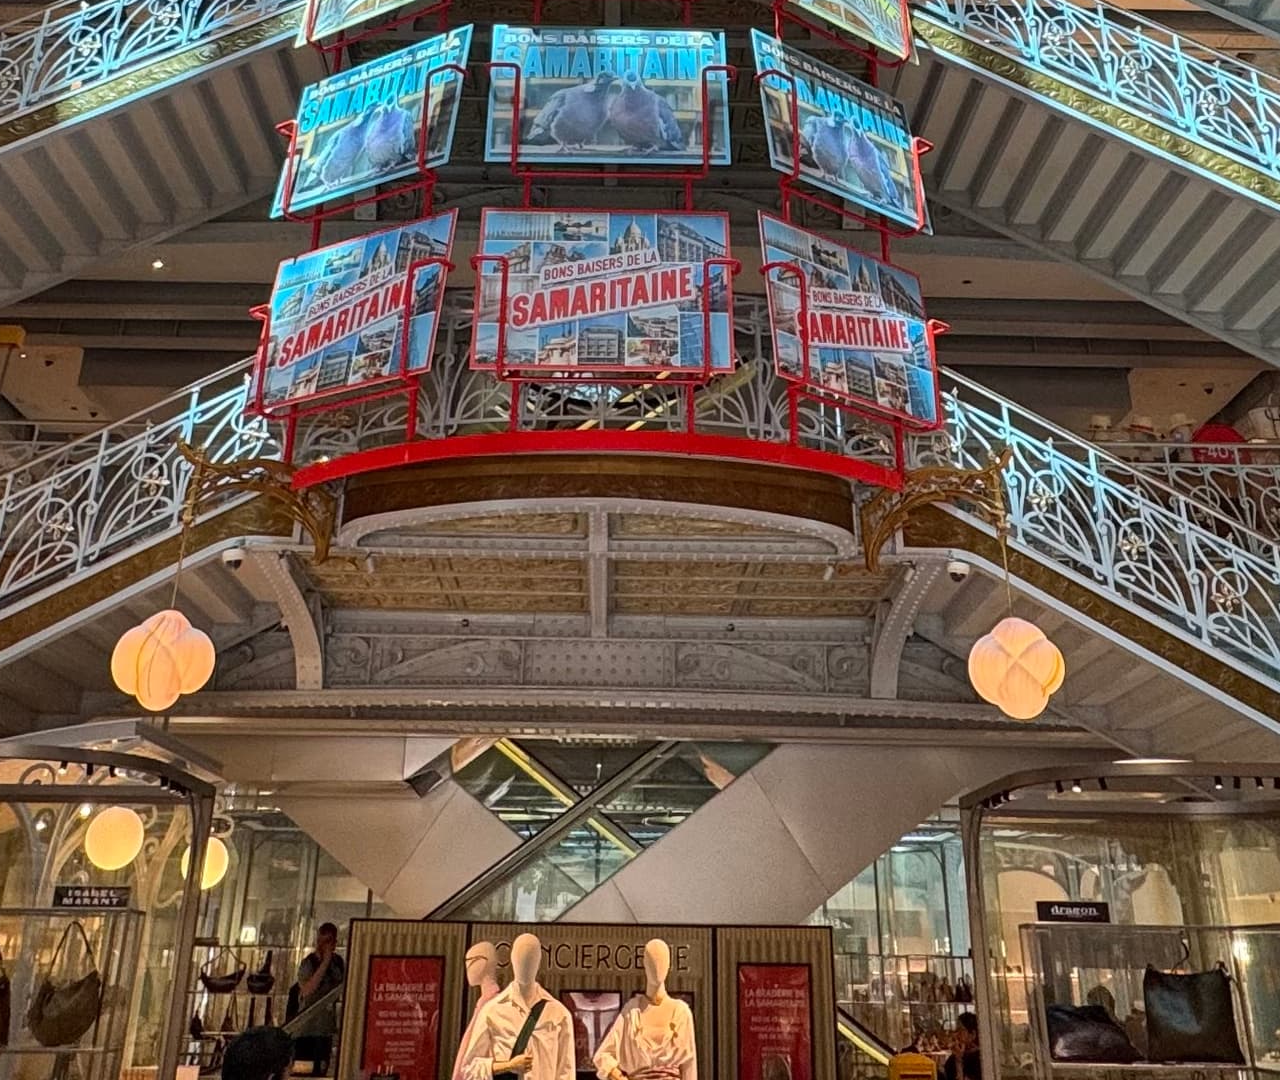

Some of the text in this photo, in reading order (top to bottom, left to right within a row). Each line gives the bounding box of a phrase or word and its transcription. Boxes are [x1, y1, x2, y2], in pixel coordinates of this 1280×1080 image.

[504, 33, 714, 46] BONS BAISERS DE LA
[309, 37, 462, 99] BONS BAISERS DE LA
[761, 42, 902, 116] BONS BAISERS DE LA
[544, 250, 658, 281] BONS BAISERS DE LA
[308, 265, 394, 316] BONS BAISERS DE LA
[512, 266, 693, 328] SAMARITAINE
[812, 290, 885, 308] BONS BAISERS DE LA
[278, 276, 411, 368] SAMARITAIN
[62, 897, 120, 906] MARANT
[68, 888, 117, 897] ISABEL
[495, 940, 690, 972] CNCIERGEIE
[745, 989, 754, 998] LA
